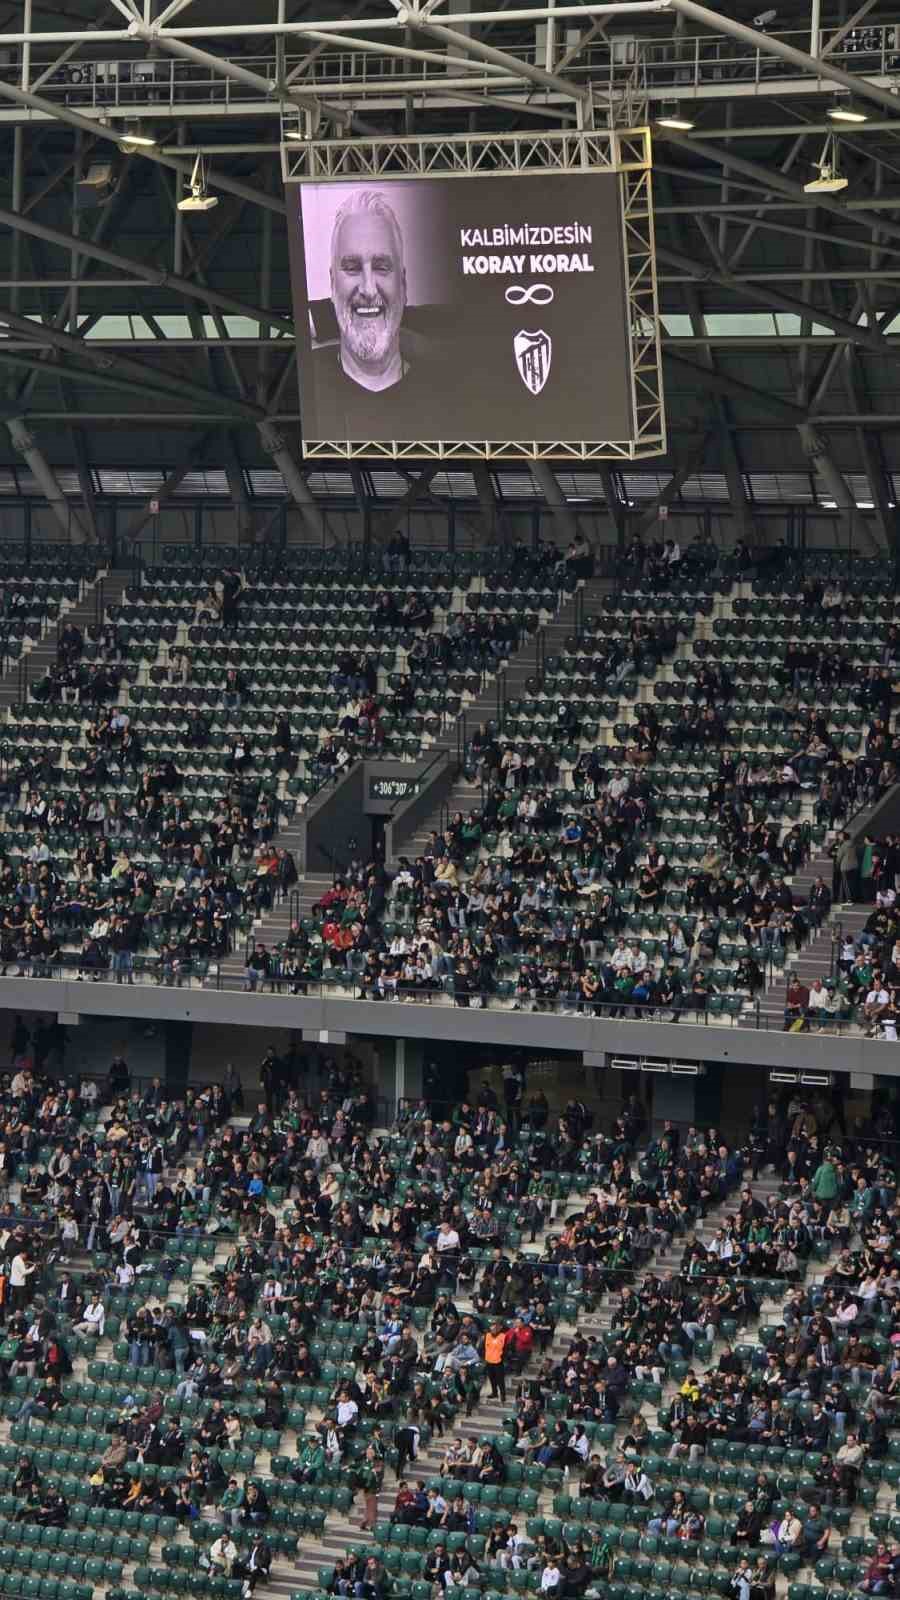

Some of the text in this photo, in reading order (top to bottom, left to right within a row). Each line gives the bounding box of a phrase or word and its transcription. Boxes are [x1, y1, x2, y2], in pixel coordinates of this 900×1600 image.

[460, 221, 592, 247] KALBİMİZDESİN
[462, 253, 594, 274] KORAY KORAL
